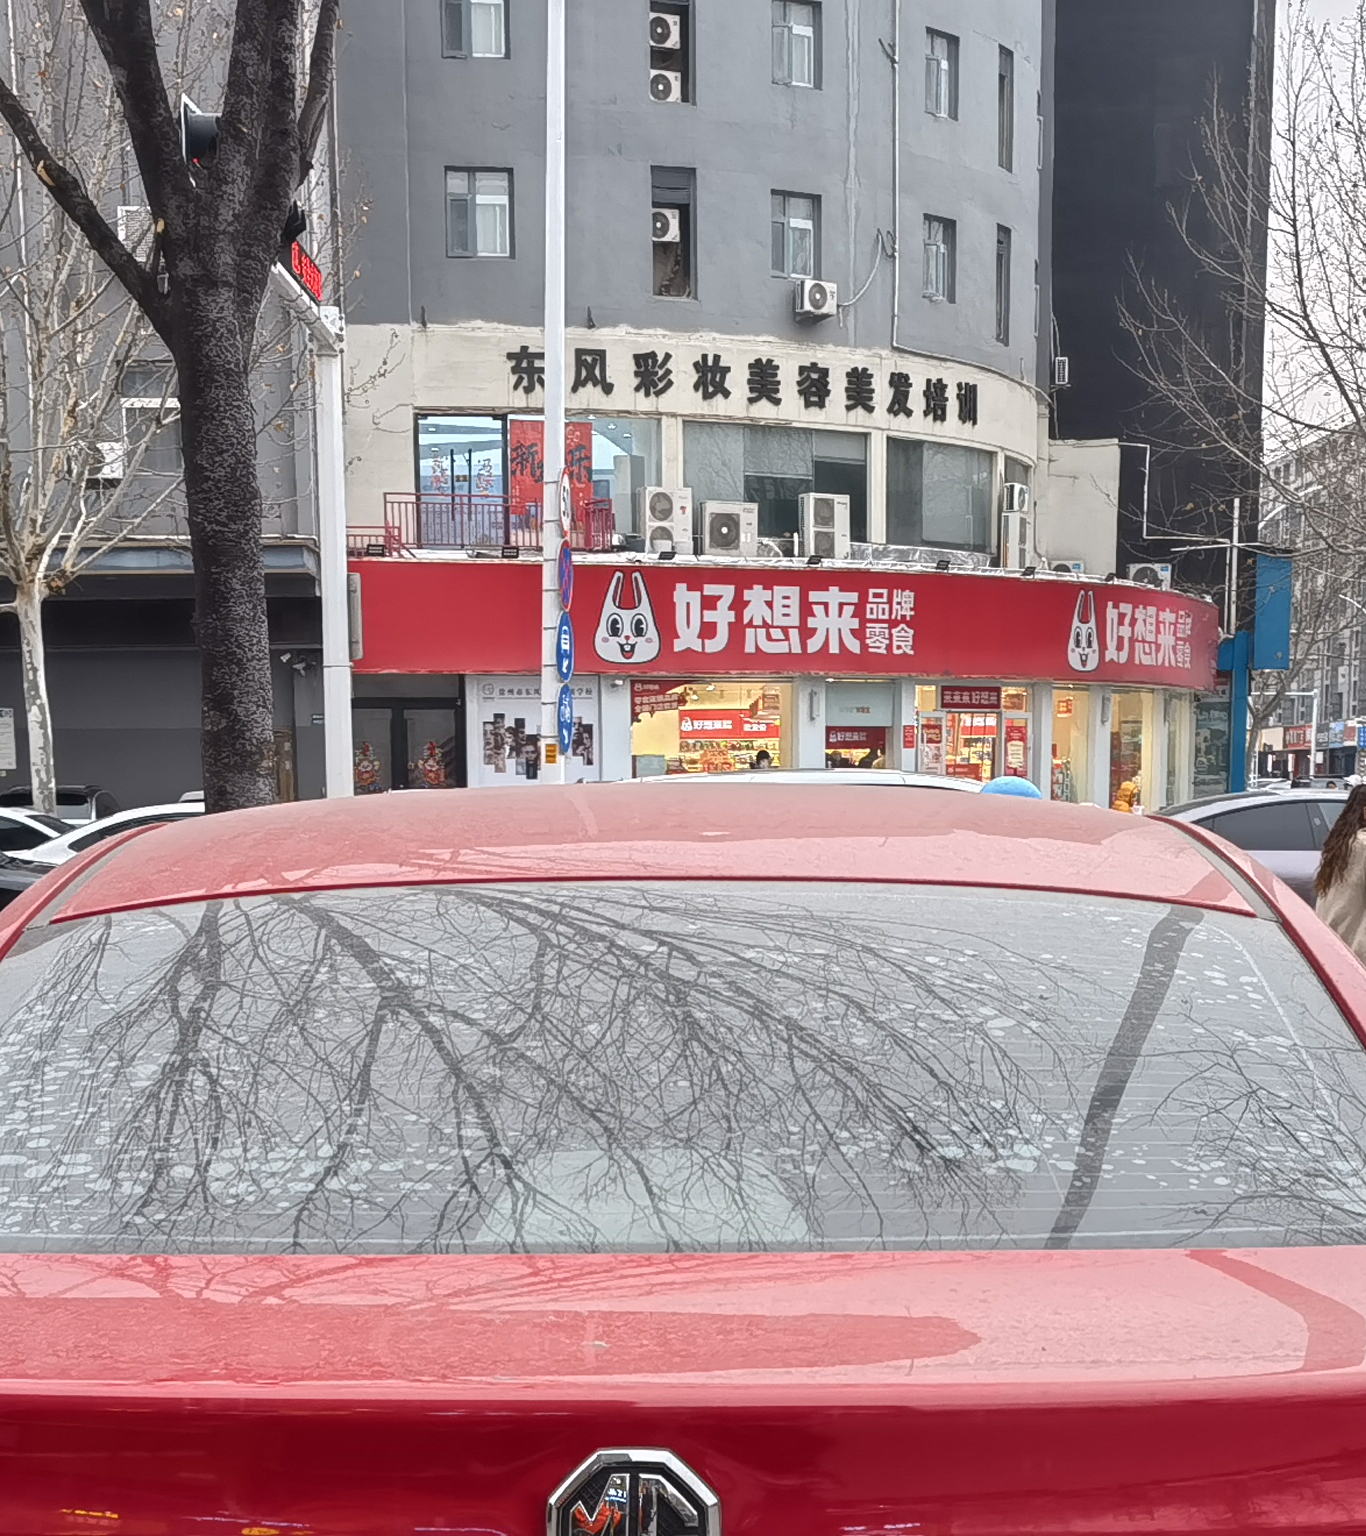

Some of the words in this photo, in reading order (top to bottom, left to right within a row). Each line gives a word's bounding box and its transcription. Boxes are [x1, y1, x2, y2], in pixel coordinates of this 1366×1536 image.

[506, 345, 979, 426] 东风彩妆美容美发培训
[673, 582, 862, 655] 好想来
[865, 588, 916, 621] 品牌
[1105, 601, 1176, 668] 好想来
[865, 623, 916, 655] 零食
